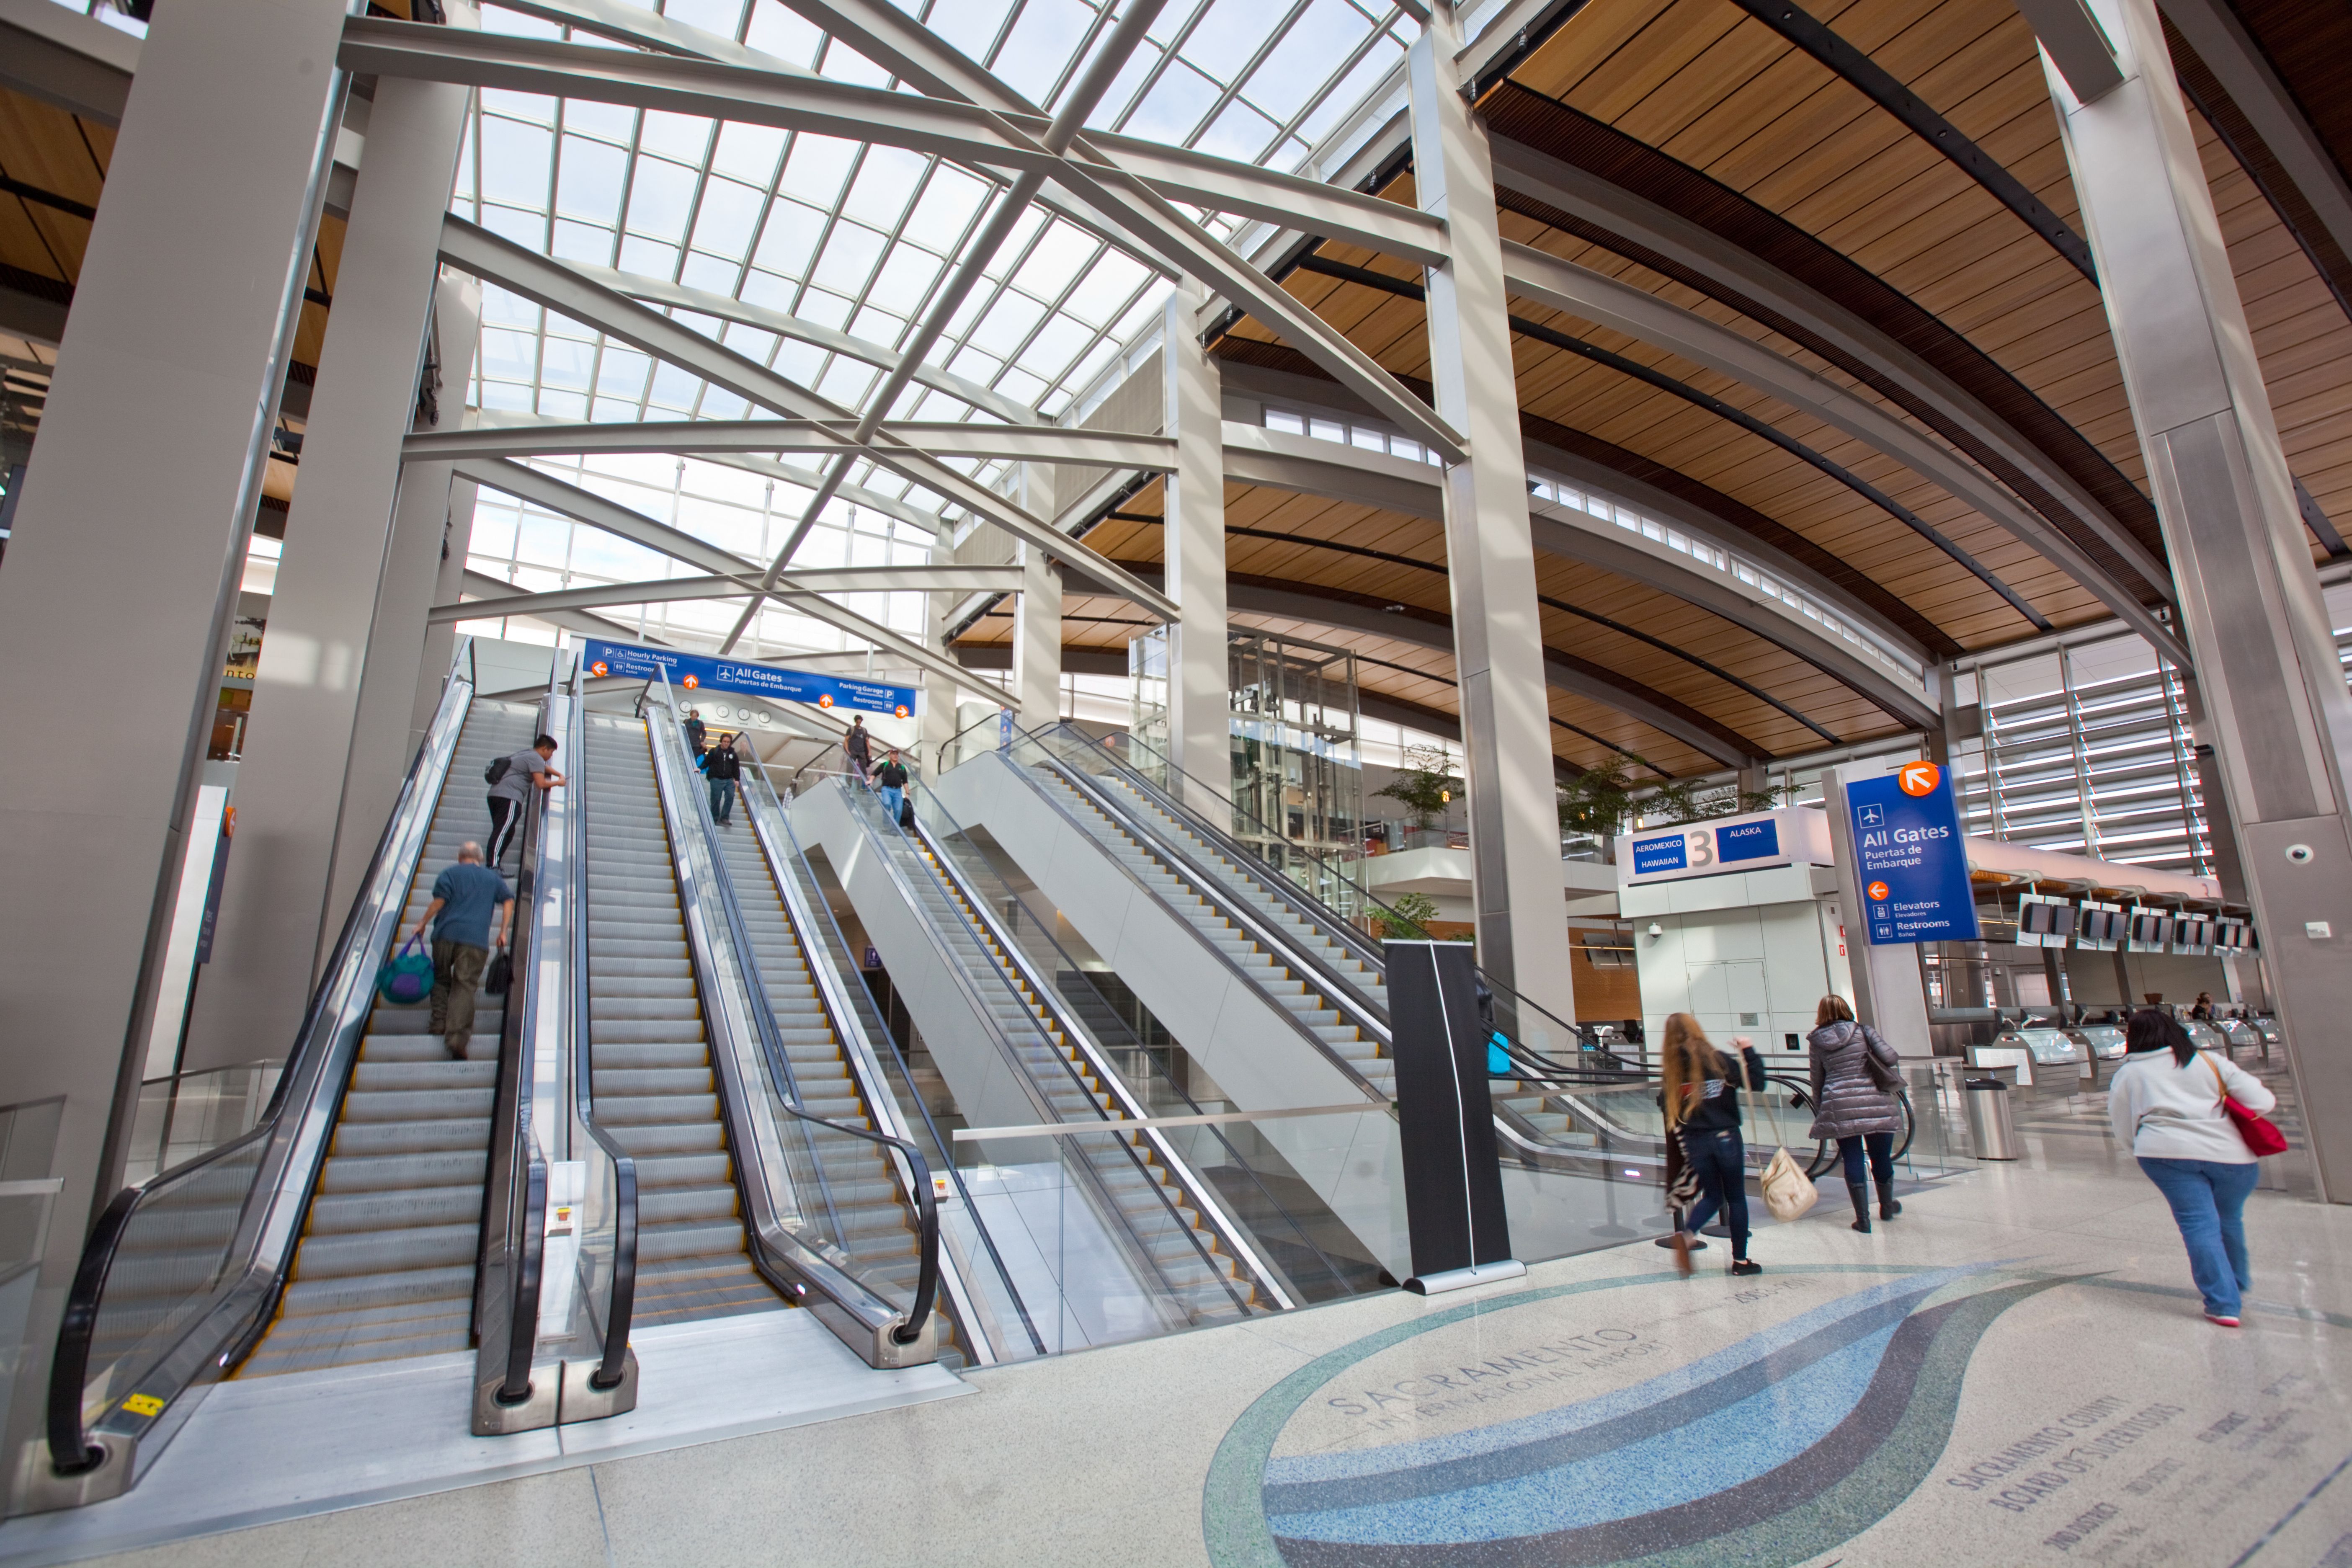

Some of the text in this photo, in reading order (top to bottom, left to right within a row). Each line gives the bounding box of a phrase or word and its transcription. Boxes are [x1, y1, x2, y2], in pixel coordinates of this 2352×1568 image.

[627, 650, 650, 660] Hourly
[652, 654, 677, 664] Parking
[626, 663, 654, 672] Restroo
[736, 668, 782, 682] All Gates
[735, 678, 759, 686] Puertas
[770, 683, 802, 693] Embarque
[839, 682, 884, 694] Parking Garage
[853, 696, 882, 706] Restrooms
[1730, 827, 1761, 838] ALASKA
[1864, 826, 1949, 848] All Gates
[1635, 840, 1682, 853] AEROMEXICO
[1690, 830, 1713, 867] 3
[1865, 845, 1922, 859] Puertas de
[1642, 857, 1679, 868] HAWAIIAN
[1867, 857, 1921, 870] Embarque
[1893, 901, 1940, 911] Elevators
[1897, 920, 1950, 930] Restrooms
[1582, 1339, 1673, 1370] AIRPORT
[1328, 1329, 1637, 1415] SACRAMENTO
[1946, 1426, 2074, 1491] SACRAMENTO
[2058, 1395, 2131, 1428] COUNTY
[1988, 1472, 2069, 1512] BOARD
[2052, 1455, 2094, 1473] OF
[2076, 1403, 2184, 1459] SUPERVISORS
